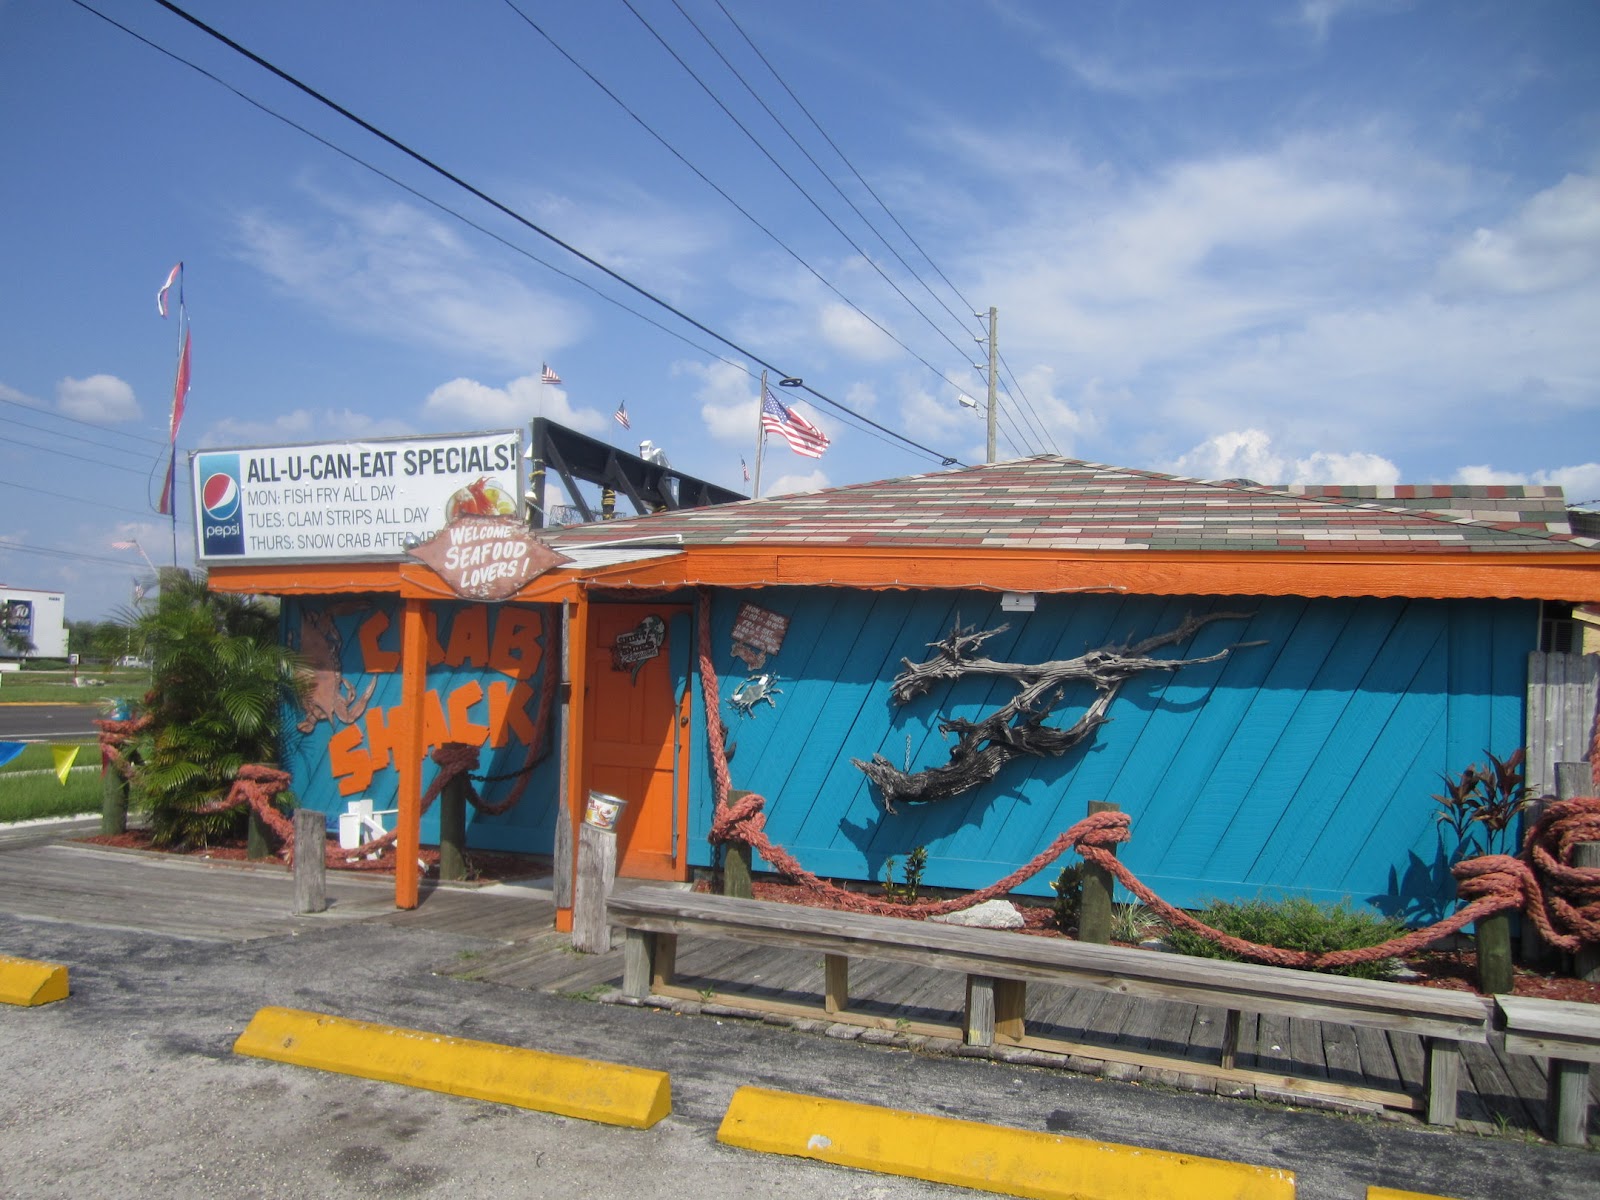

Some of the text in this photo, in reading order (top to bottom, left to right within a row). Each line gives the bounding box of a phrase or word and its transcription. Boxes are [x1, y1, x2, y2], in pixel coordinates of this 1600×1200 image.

[247, 443, 516, 483] ALL-U-CAN-EAT SPECIALS!
[248, 485, 396, 506] MON: FISH FRY ALL DAY
[248, 506, 430, 528] TUES: CLAM STRIPS ALL DAY
[206, 523, 240, 539] pepsi
[249, 535, 295, 551] THURS:
[297, 533, 334, 550] SNOW
[337, 532, 371, 549] CRAB
[450, 525, 512, 546] WELCOME
[444, 541, 527, 570] SEAFOOD
